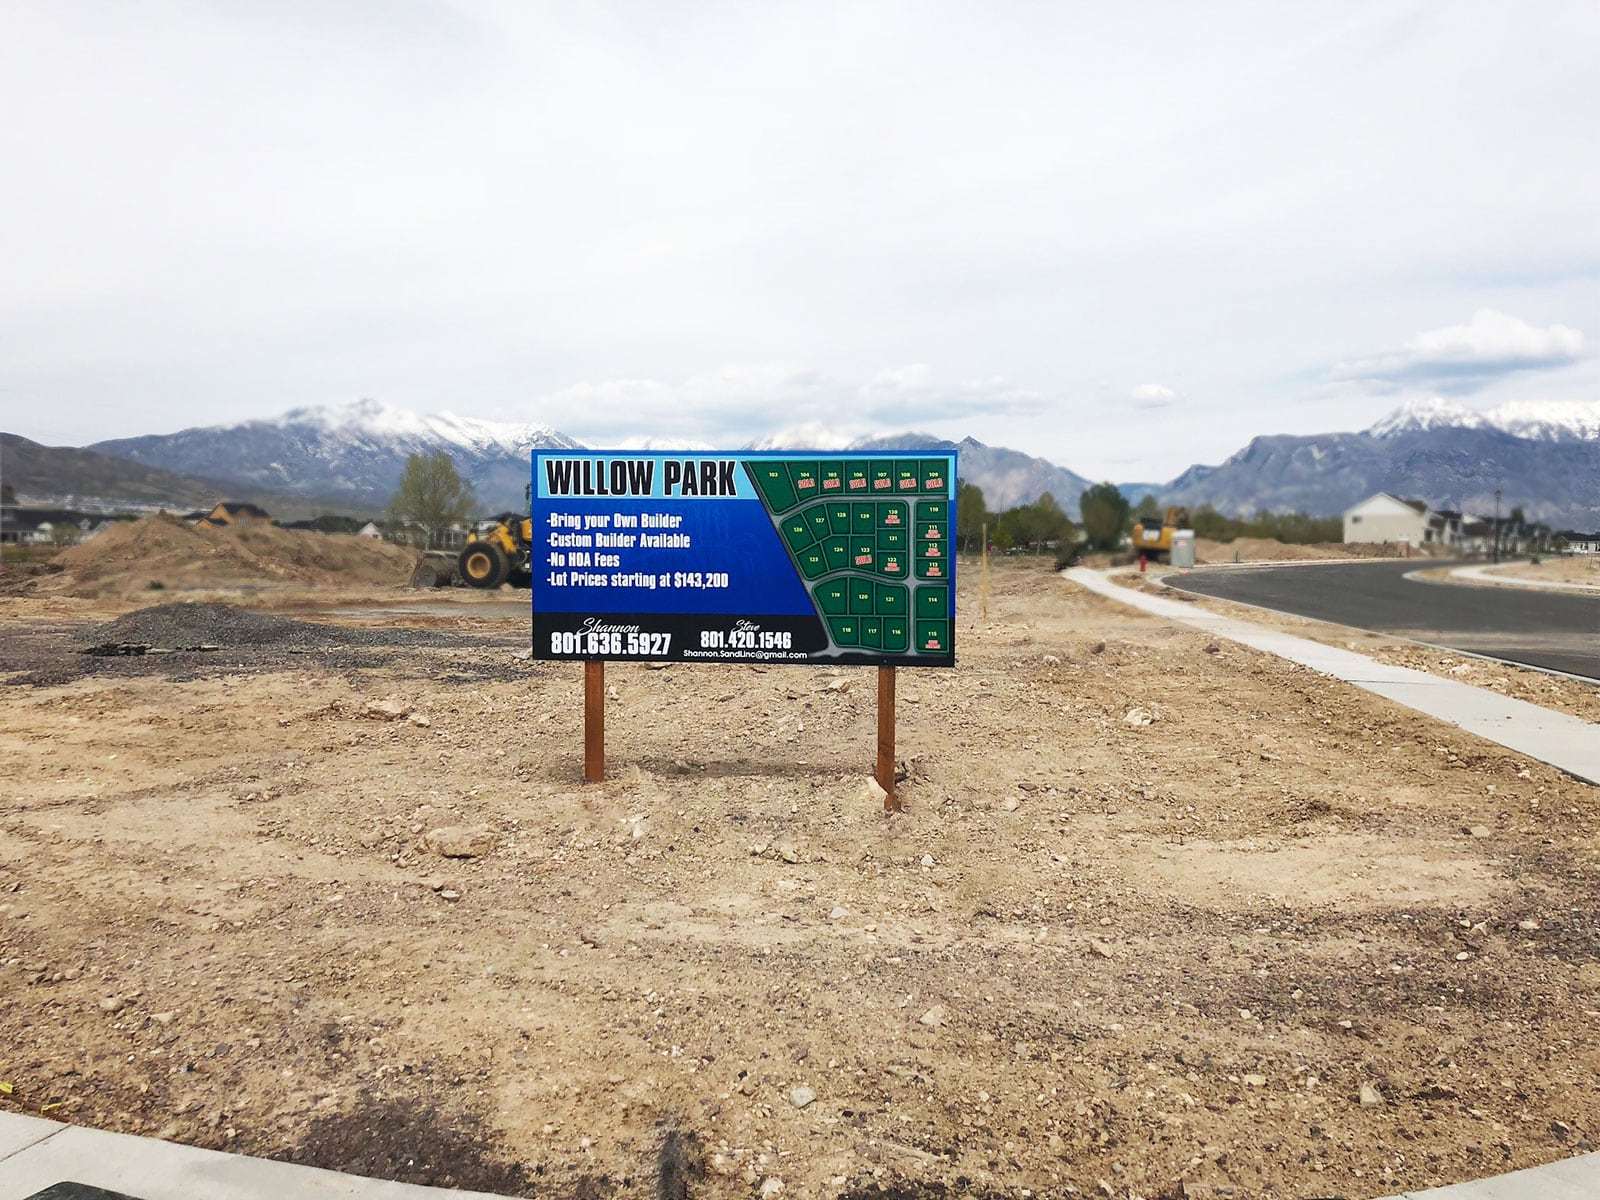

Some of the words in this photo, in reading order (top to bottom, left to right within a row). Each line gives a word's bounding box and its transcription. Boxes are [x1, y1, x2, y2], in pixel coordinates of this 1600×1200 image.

[546, 460, 655, 497] WILLOW
[664, 460, 738, 497] PARK
[547, 512, 582, 530] -Bring
[584, 514, 611, 530] your
[613, 513, 639, 529] Own
[641, 513, 683, 529] Builder
[547, 532, 592, 548] -Custom
[595, 532, 637, 548] Builder
[639, 532, 691, 549] Available
[547, 551, 566, 567] -No
[568, 551, 592, 567] HOA
[594, 551, 620, 567] Fees
[547, 571, 569, 587] -Lot
[571, 571, 608, 588] Prices
[610, 571, 656, 590] starting
[659, 571, 671, 588] at
[674, 571, 729, 590] $143,200
[574, 616, 641, 637] Shannon
[730, 619, 760, 634] Steve
[550, 631, 672, 656] 801.636.5927
[700, 630, 792, 650] 801.420.1546
